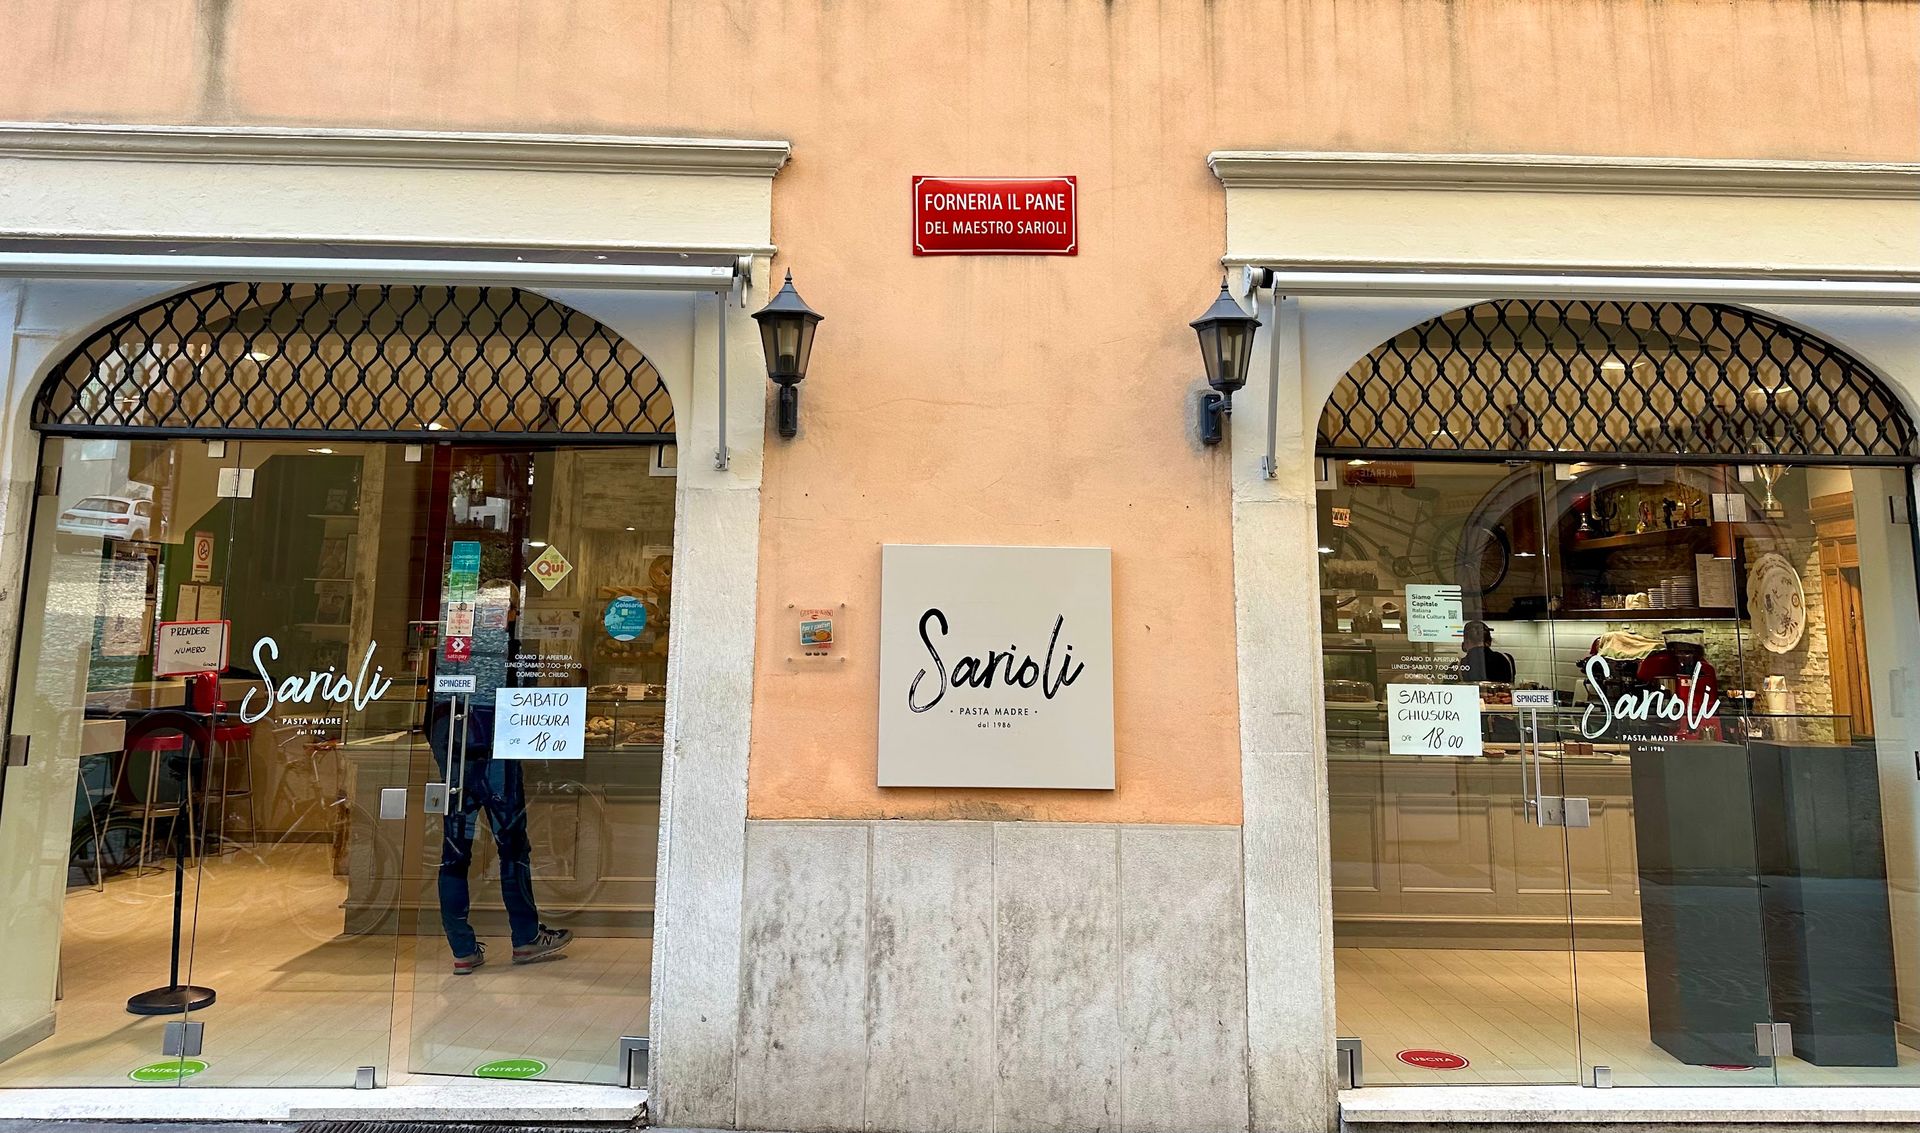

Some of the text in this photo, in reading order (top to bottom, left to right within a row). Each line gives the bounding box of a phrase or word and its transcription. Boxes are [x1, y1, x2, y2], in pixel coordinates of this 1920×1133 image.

[925, 193, 1066, 211] FORNERIA IL PANE
[925, 221, 1067, 235] DEL MAESTRO SARIOLI
[537, 560, 564, 577] Qui
[170, 626, 211, 636] PRENDERE
[173, 646, 207, 655] NUMERO
[908, 608, 1085, 713] Sarioli
[239, 636, 393, 724] Sarioli
[439, 679, 472, 688] SPINGERE
[510, 692, 569, 708] SABATO
[1398, 690, 1453, 705] SABATO
[1516, 694, 1549, 703] SPINGERE
[1581, 654, 1721, 740] Sarioli
[959, 707, 1029, 716] PASTA MADRE
[1397, 708, 1460, 722] CHIUSURA
[509, 713, 570, 727] CHIUSURA
[1622, 734, 1648, 742] PASTA
[541, 935, 553, 945] N
